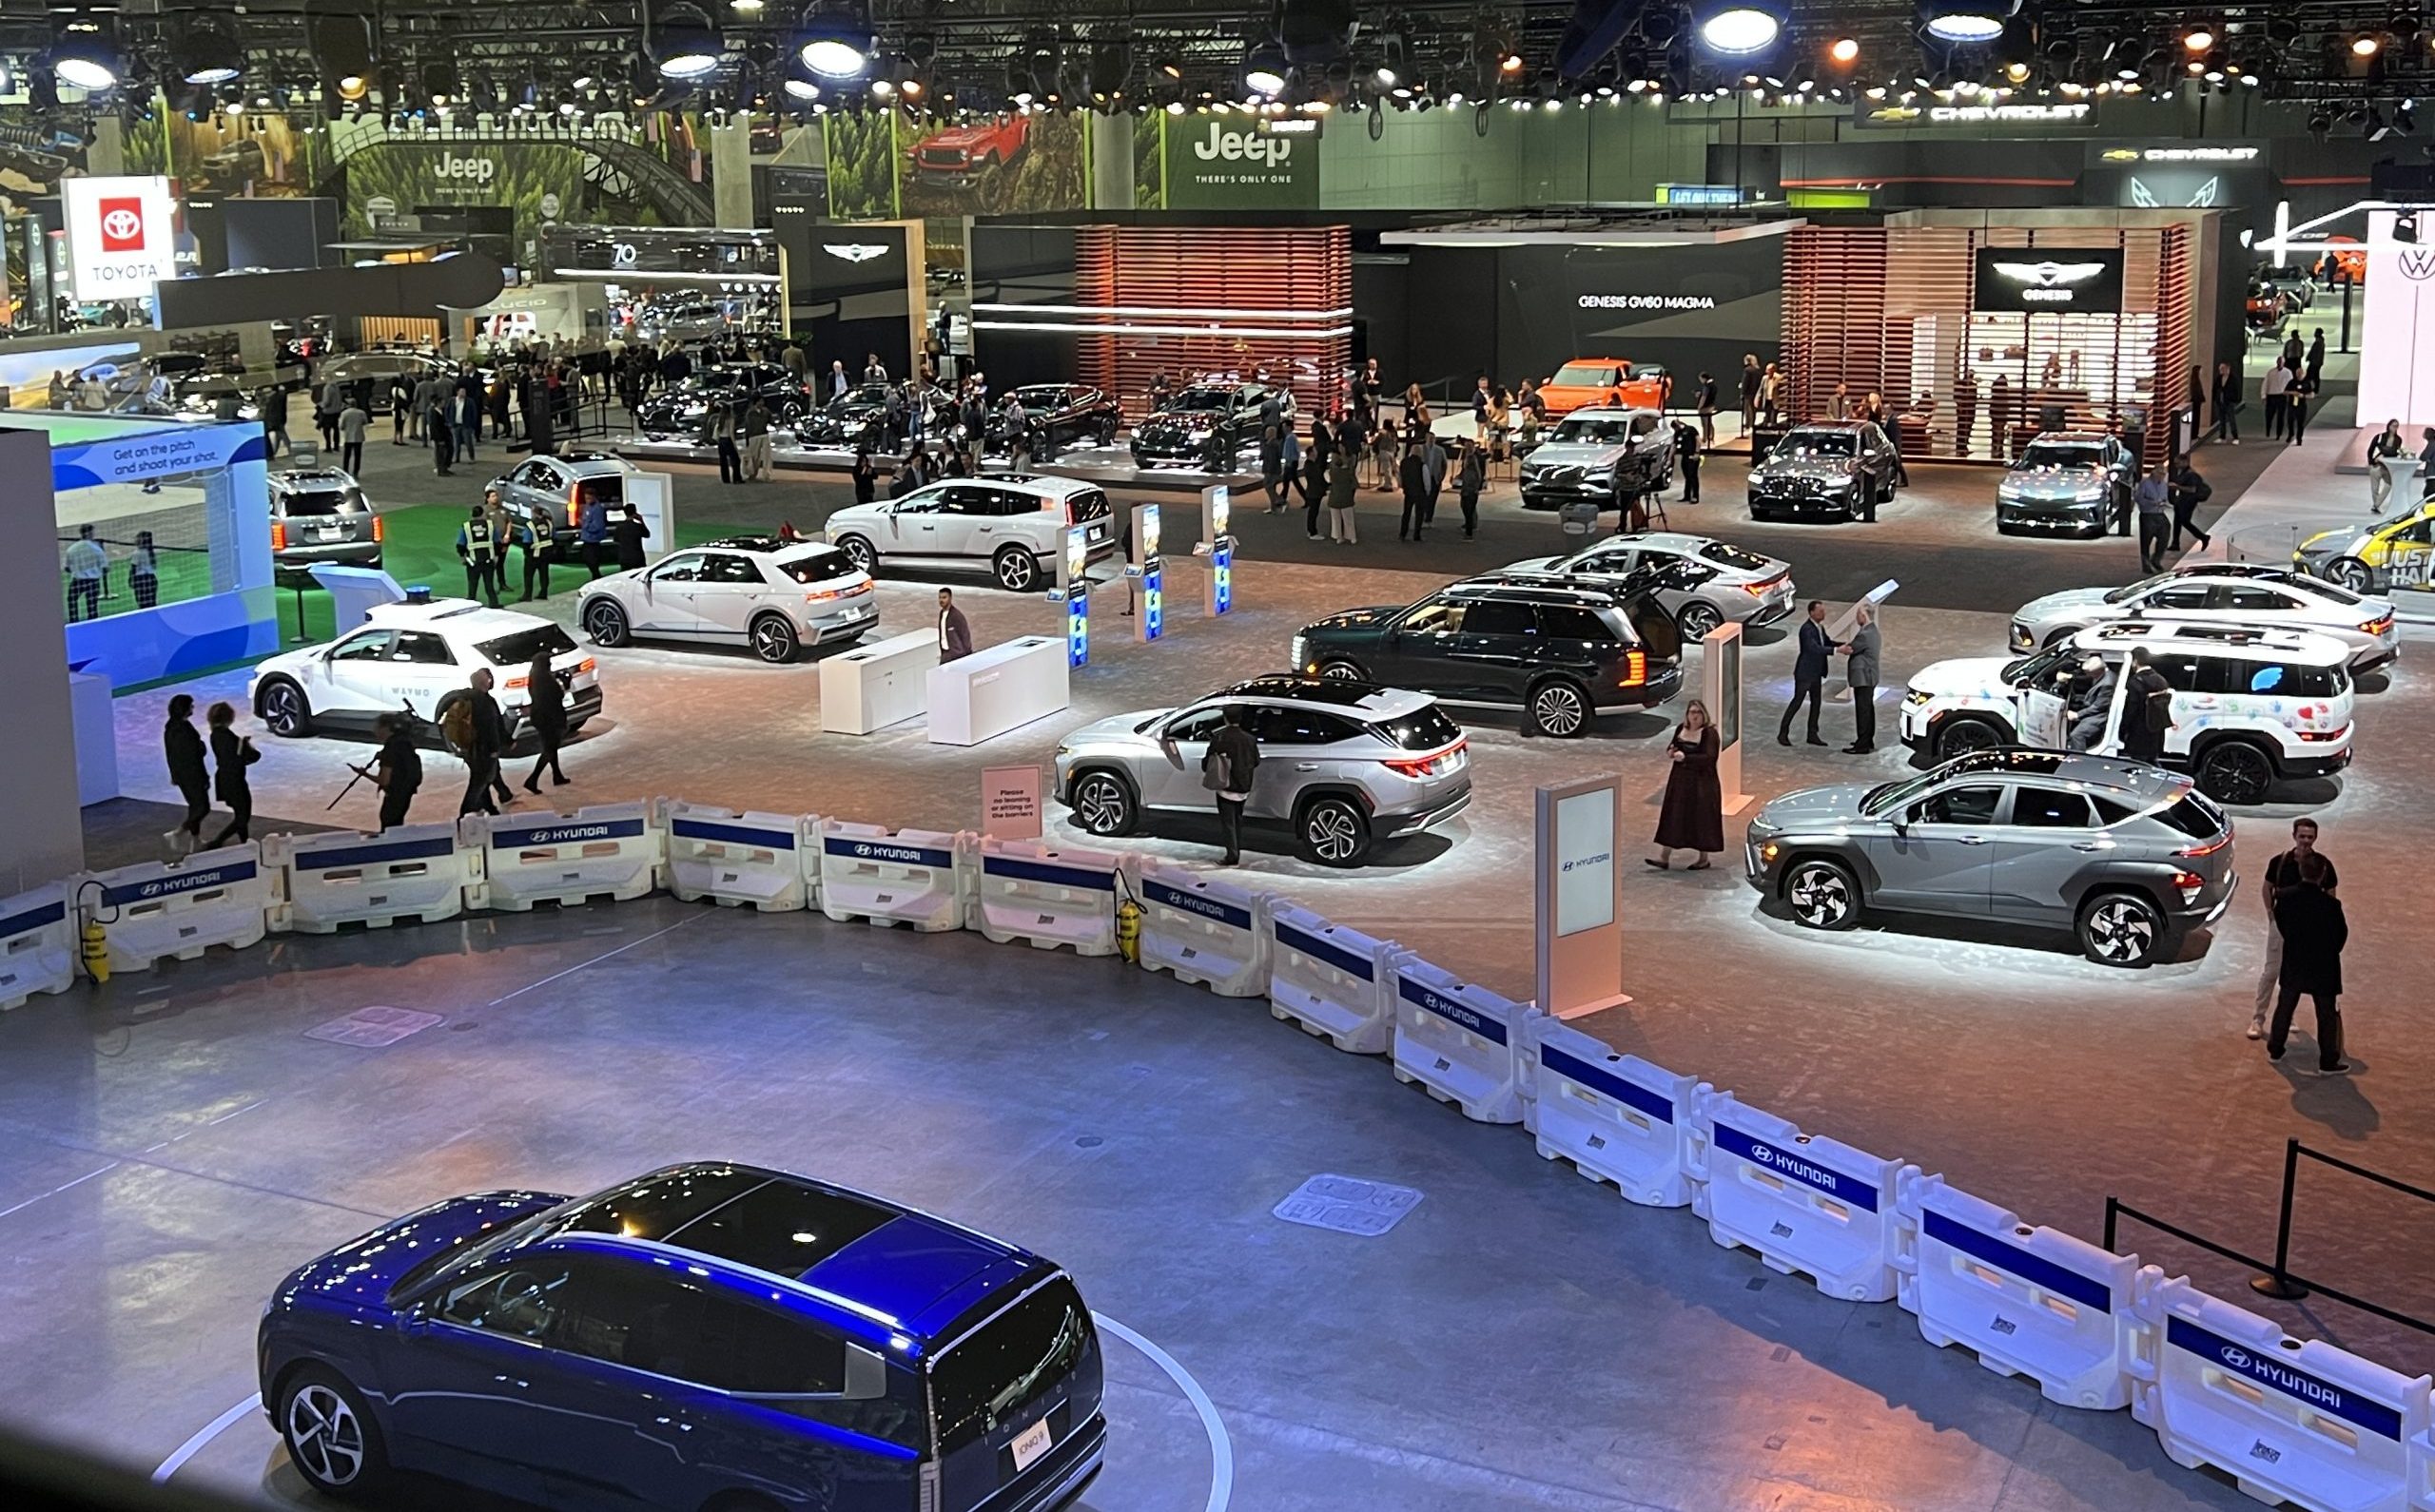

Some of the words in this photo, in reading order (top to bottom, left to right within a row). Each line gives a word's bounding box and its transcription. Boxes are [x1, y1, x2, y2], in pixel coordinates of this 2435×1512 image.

[1930, 104, 2090, 121] CHEVROLET
[1195, 122, 1291, 167] Jeep
[434, 151, 494, 184] Jeep
[1196, 175, 1236, 184] THERE'S
[1239, 175, 1267, 184] ONLY
[1271, 175, 1292, 184] ONE
[612, 243, 637, 263] 70
[93, 264, 158, 281] TOYOTA
[1578, 296, 1627, 308] GENESIS
[1628, 296, 1663, 309] GV60
[1665, 297, 1715, 309] MAGMA
[114, 449, 133, 460] Get
[135, 448, 148, 457] on
[150, 444, 167, 456] the
[169, 439, 195, 454] pitch
[114, 462, 136, 475] and
[139, 458, 167, 472] shoot
[169, 456, 192, 469] your
[553, 825, 608, 840] HYUNDAI
[873, 846, 921, 861] HYUNDAI
[1576, 852, 1610, 867] HYUNDAI
[163, 871, 221, 891] HYUNDAI
[1183, 896, 1224, 918] HYUNDAI
[1439, 1000, 1480, 1028] HYUNDAI
[1776, 1153, 1837, 1190] HYUNDAI
[2255, 1359, 2341, 1408] HYUNDAI
